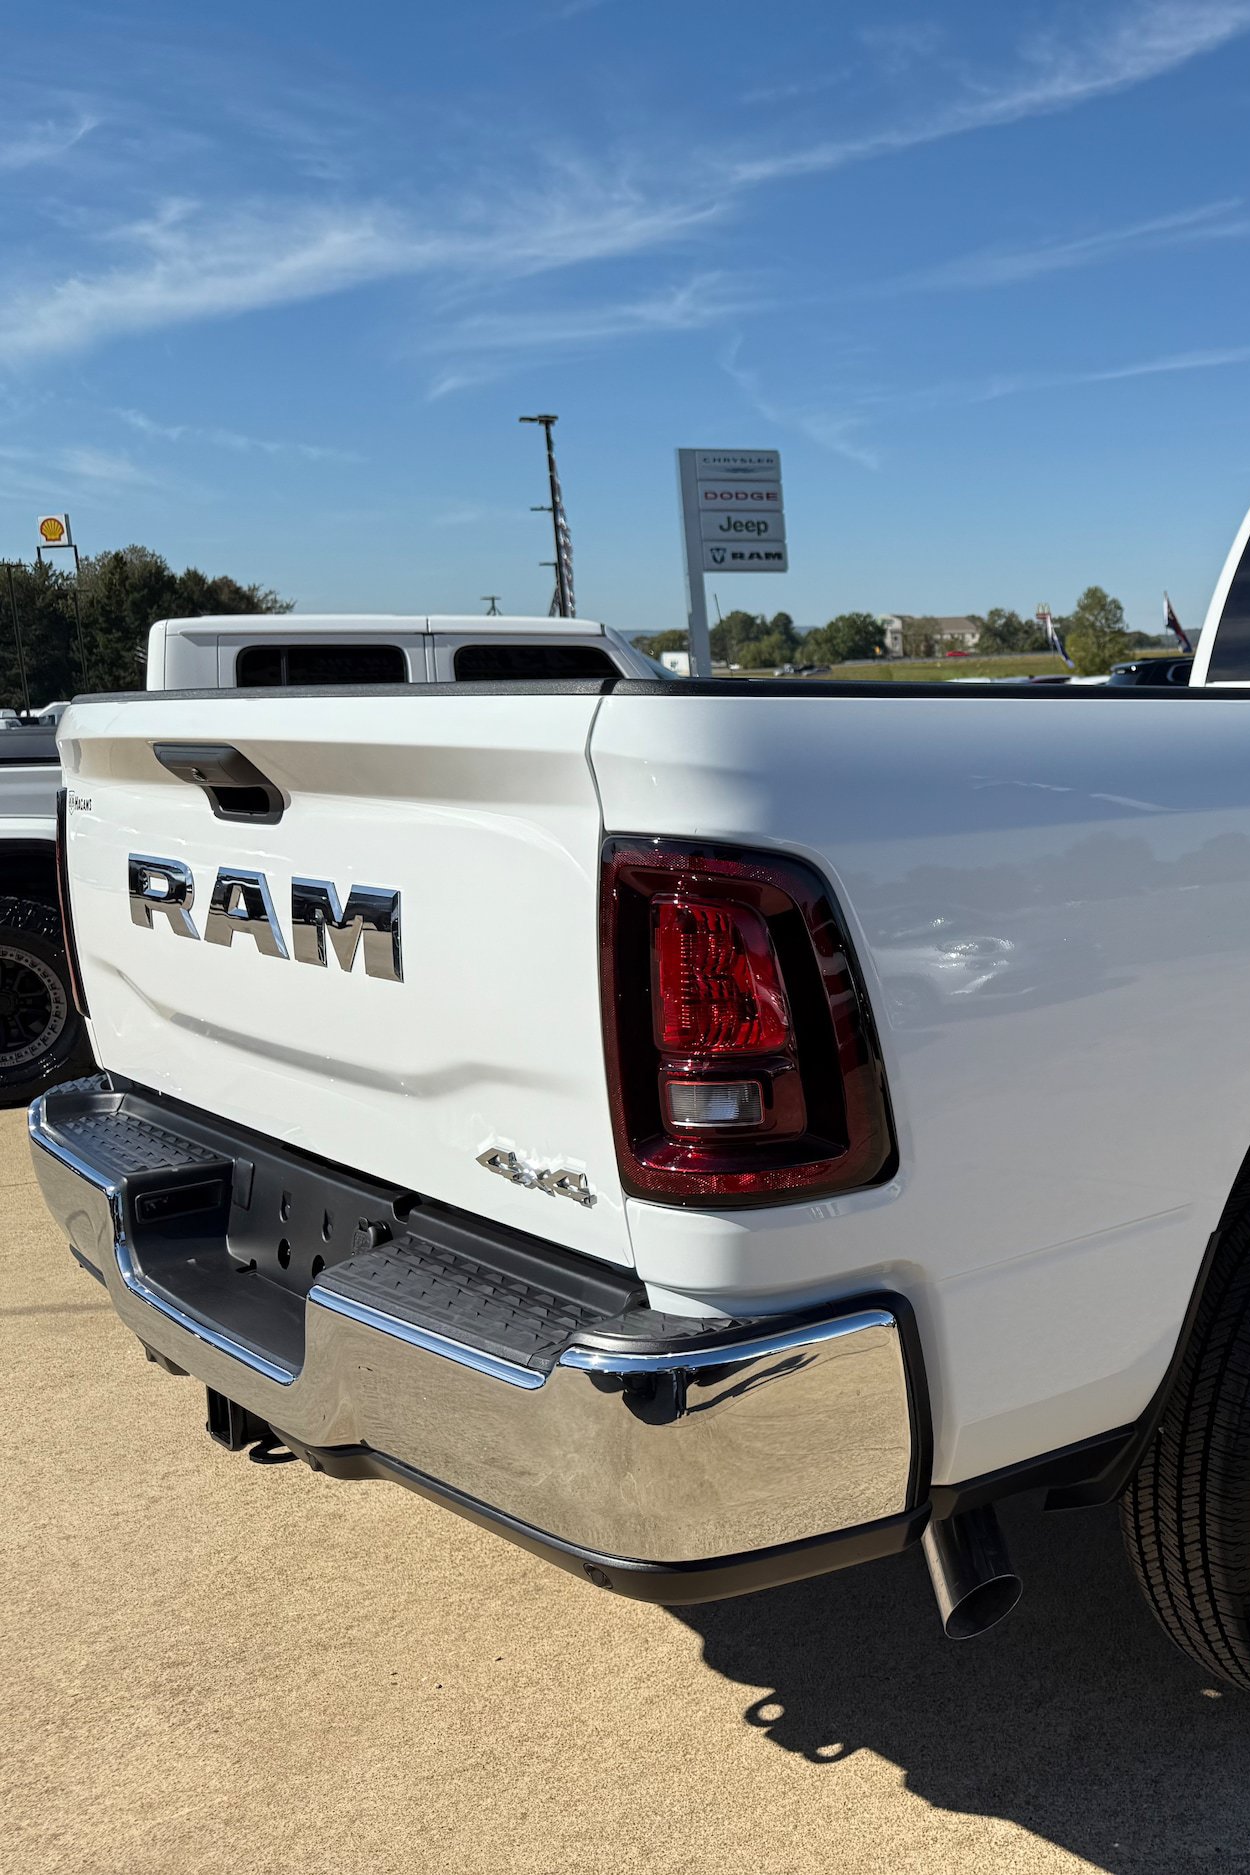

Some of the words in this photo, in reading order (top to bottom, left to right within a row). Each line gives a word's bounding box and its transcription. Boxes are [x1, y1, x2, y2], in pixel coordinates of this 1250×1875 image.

[704, 491, 778, 501] DODGE
[719, 516, 769, 536] Jeep
[731, 552, 783, 561] RAM
[127, 852, 405, 984] RAM
